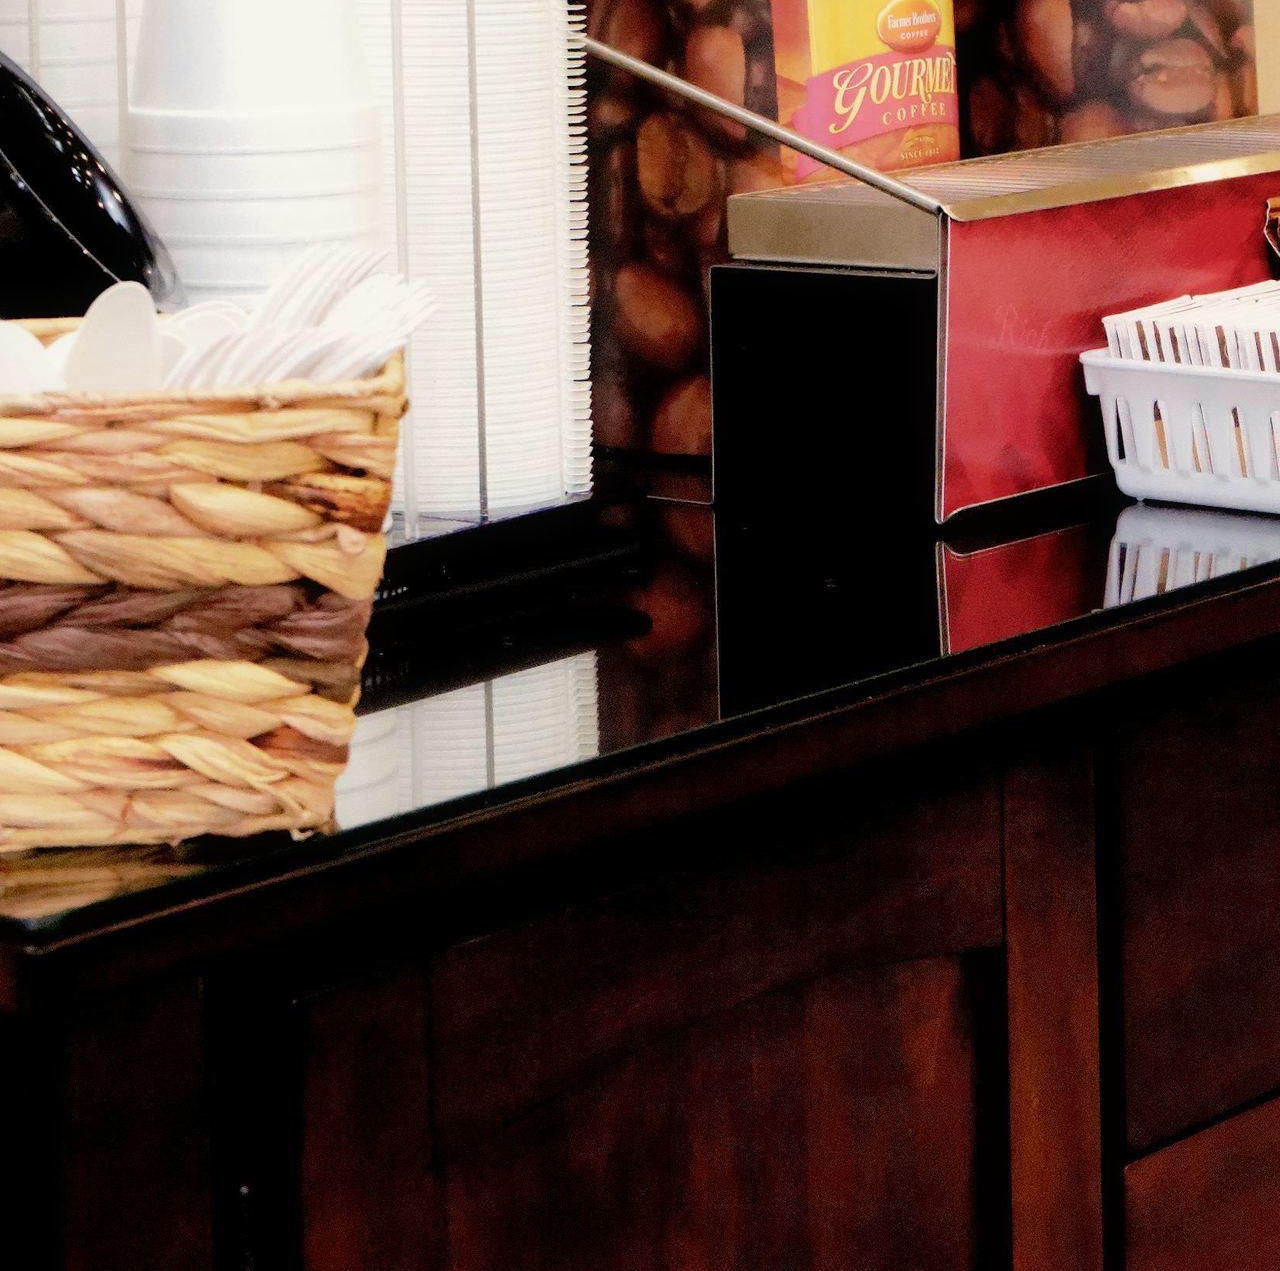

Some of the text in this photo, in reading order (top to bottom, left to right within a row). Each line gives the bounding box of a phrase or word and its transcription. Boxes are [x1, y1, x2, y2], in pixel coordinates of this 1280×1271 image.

[888, 10, 936, 29] Farmer Brothers
[900, 29, 928, 40] COFFEE
[882, 102, 946, 125] COFFEE
